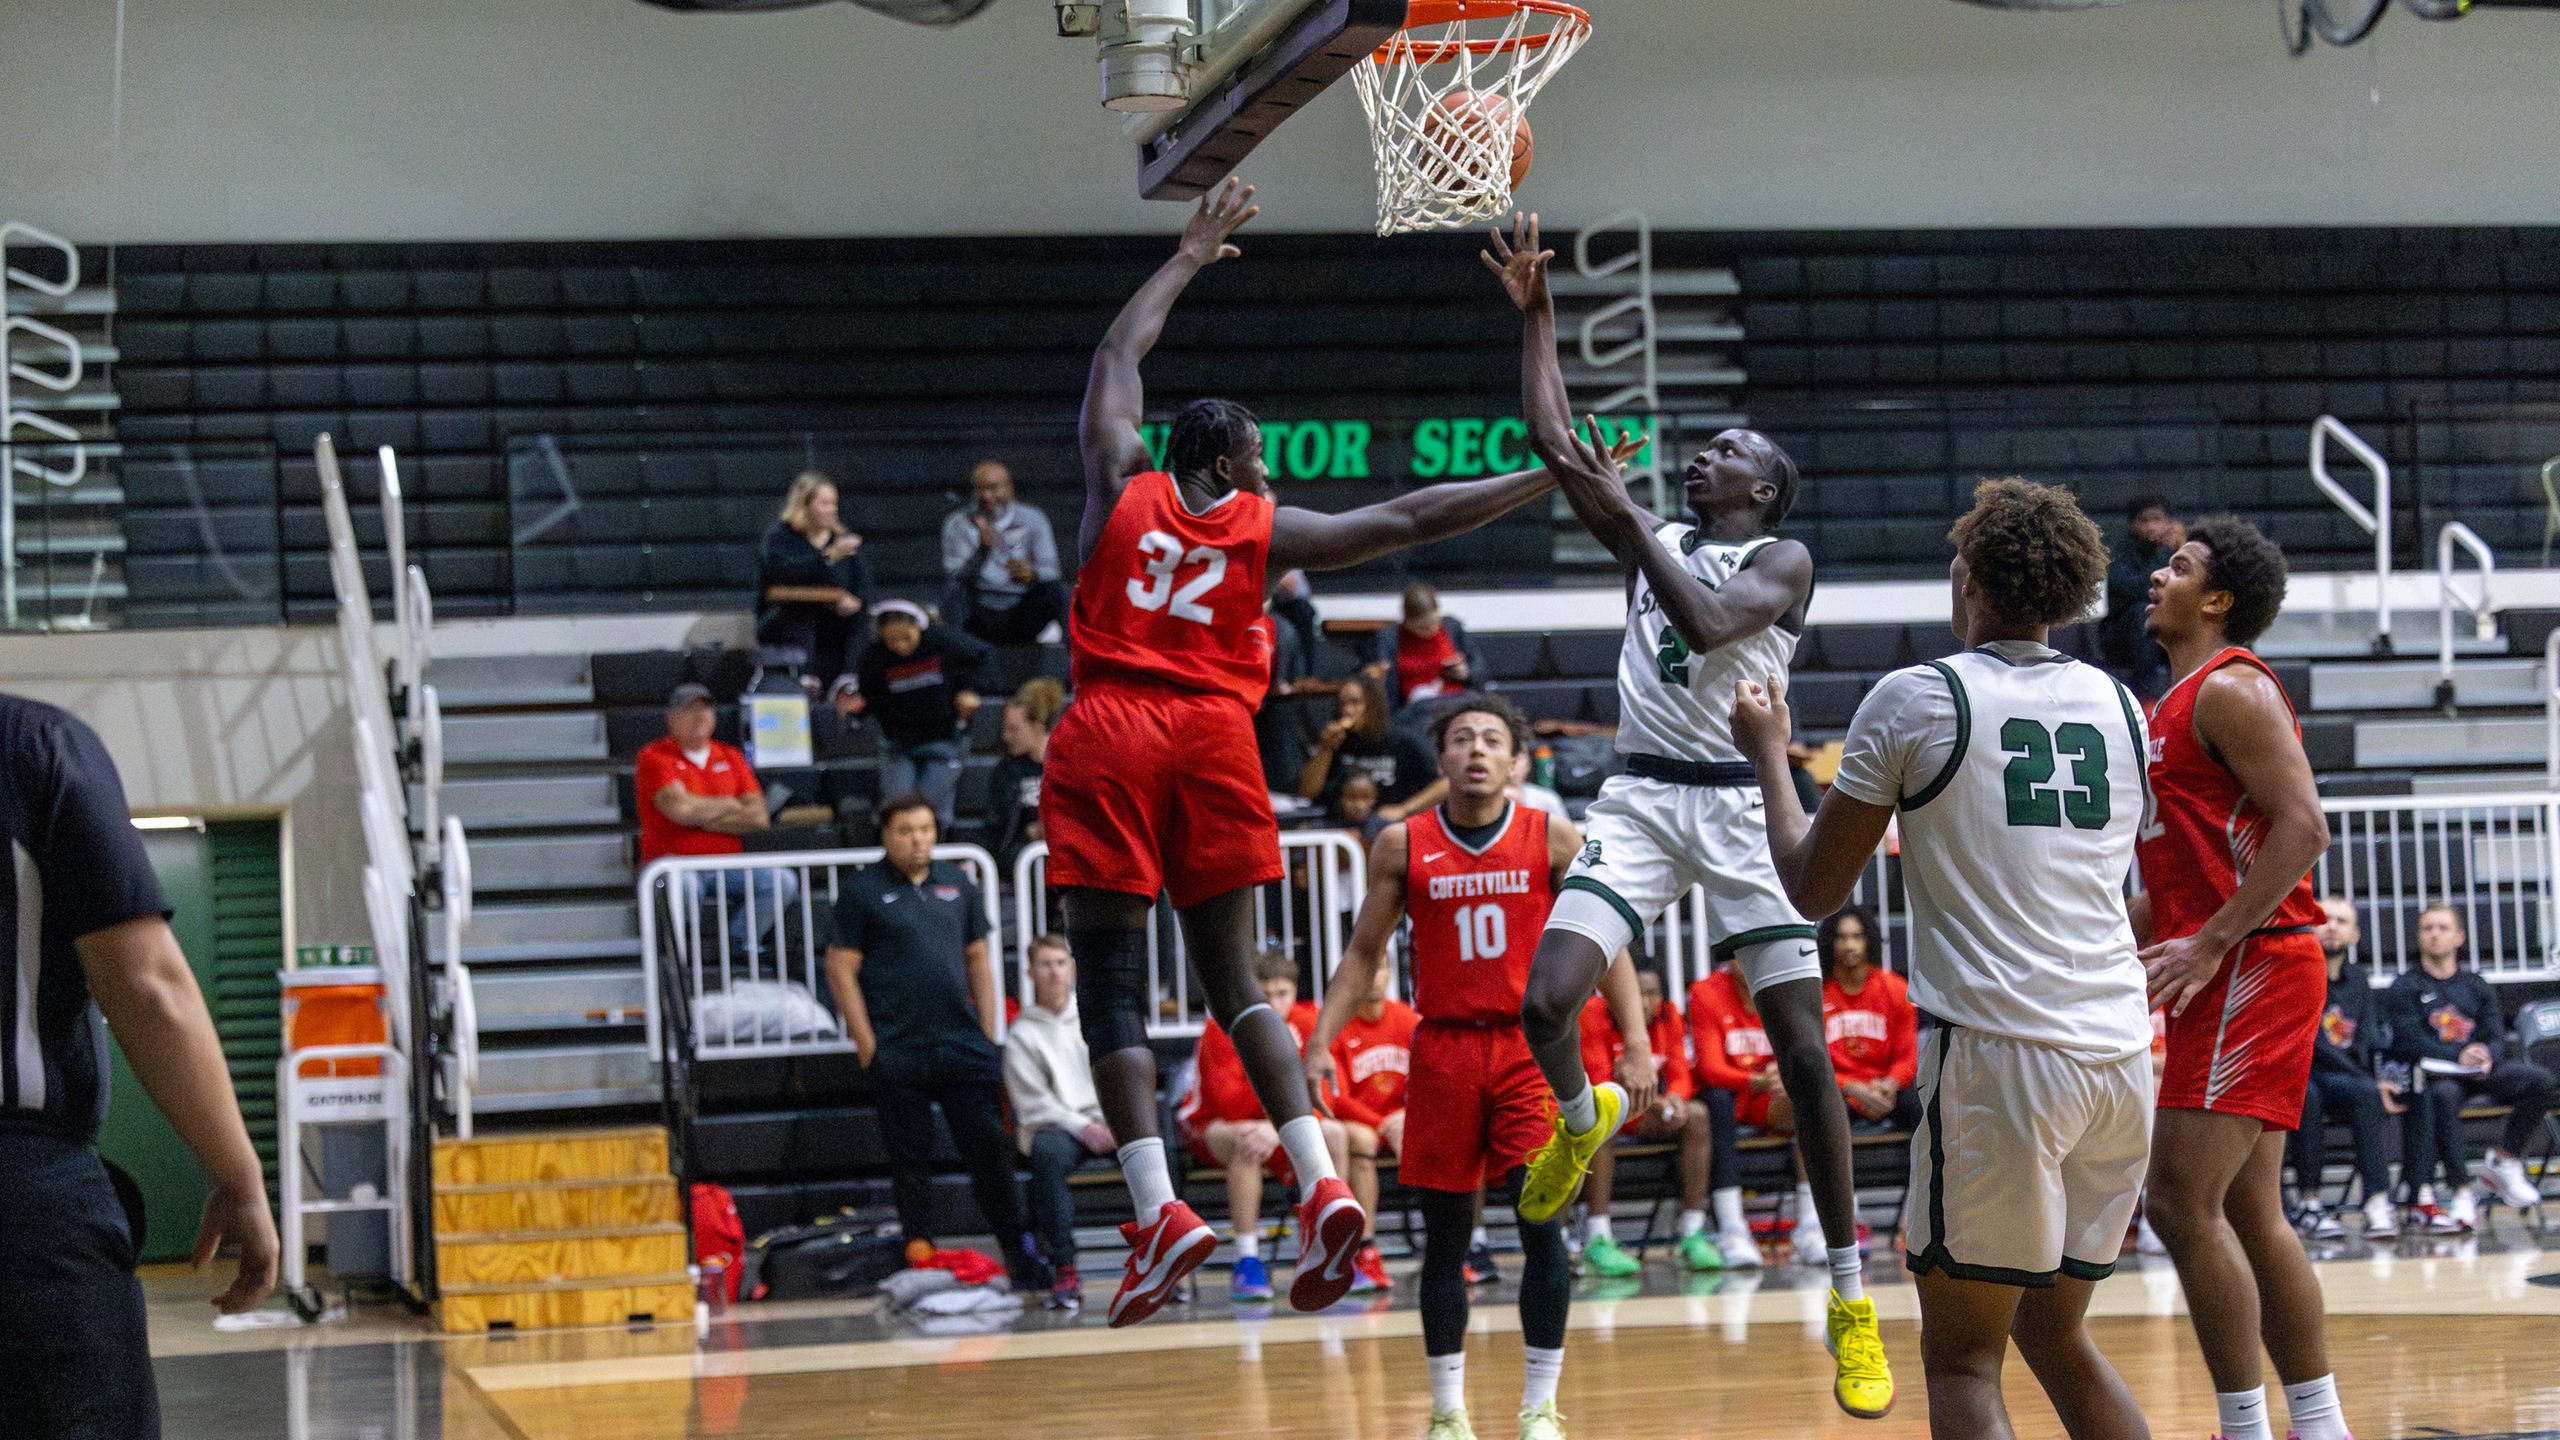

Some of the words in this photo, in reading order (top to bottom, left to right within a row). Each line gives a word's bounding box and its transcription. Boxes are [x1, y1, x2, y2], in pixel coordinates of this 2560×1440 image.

[1125, 529, 1228, 626] 32
[1657, 625, 1690, 688] 2
[2000, 717, 2111, 831] 23
[1429, 869, 1530, 900] COFFEYVILLE
[1453, 903, 1507, 962] 10
